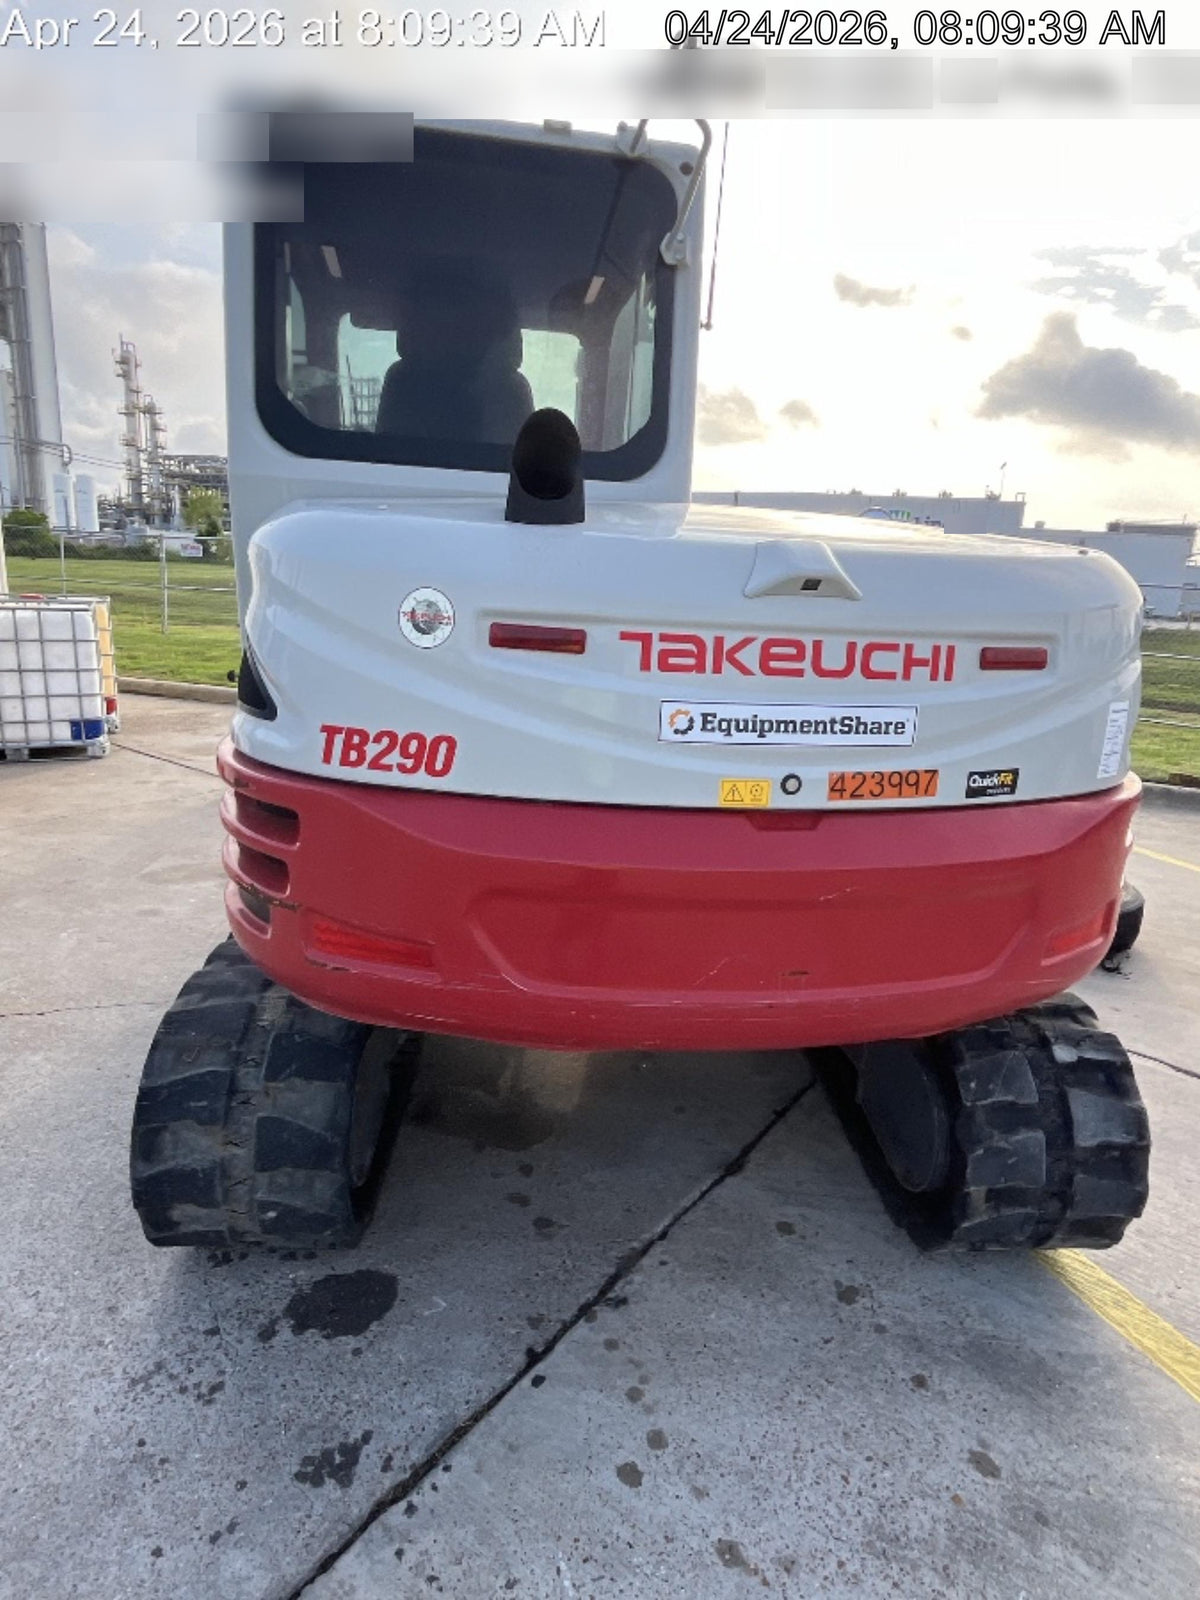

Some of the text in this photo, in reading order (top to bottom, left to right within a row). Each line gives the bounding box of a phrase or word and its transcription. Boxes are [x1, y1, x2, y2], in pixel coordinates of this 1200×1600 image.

[700, 712, 906, 738] EquipmentShare
[319, 724, 457, 778] TB290
[830, 770, 939, 799] 423997
